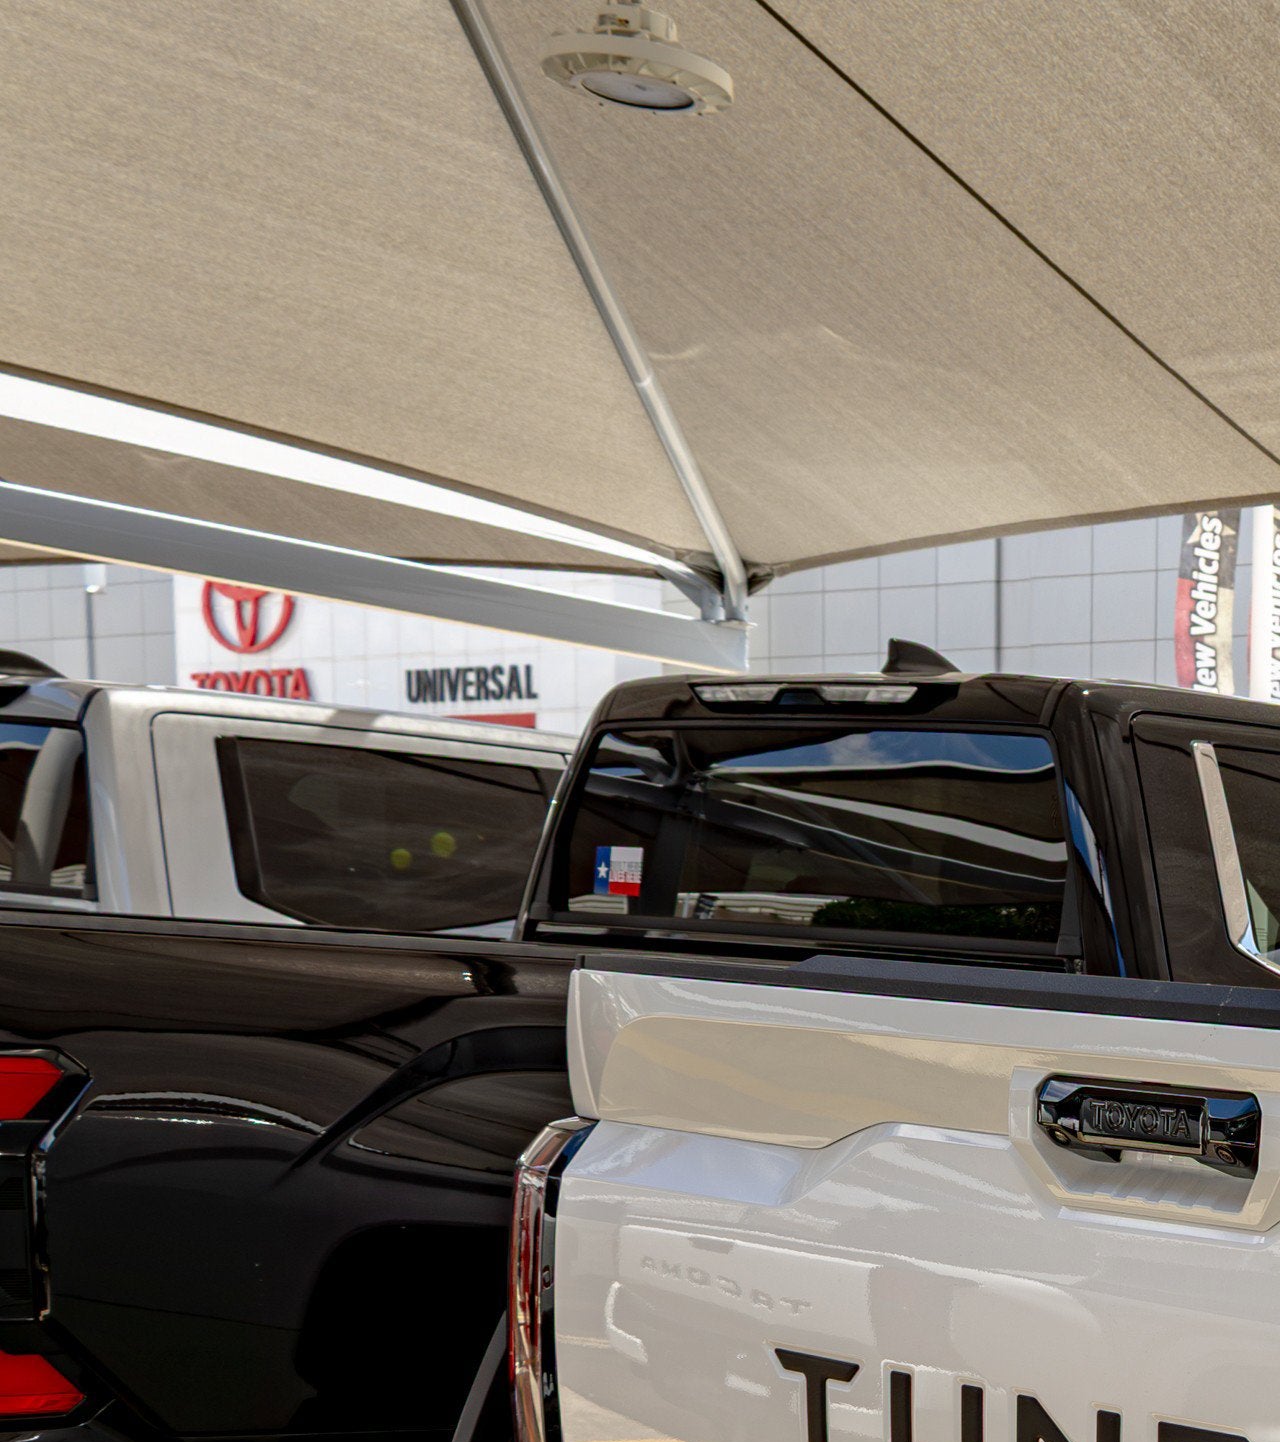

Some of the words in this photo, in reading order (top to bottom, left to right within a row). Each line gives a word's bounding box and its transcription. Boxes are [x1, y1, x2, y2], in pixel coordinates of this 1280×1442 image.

[1190, 514, 1223, 636] Vehicles
[405, 664, 539, 703] UNIVERSAL
[1089, 1100, 1191, 1139] TOYOTA
